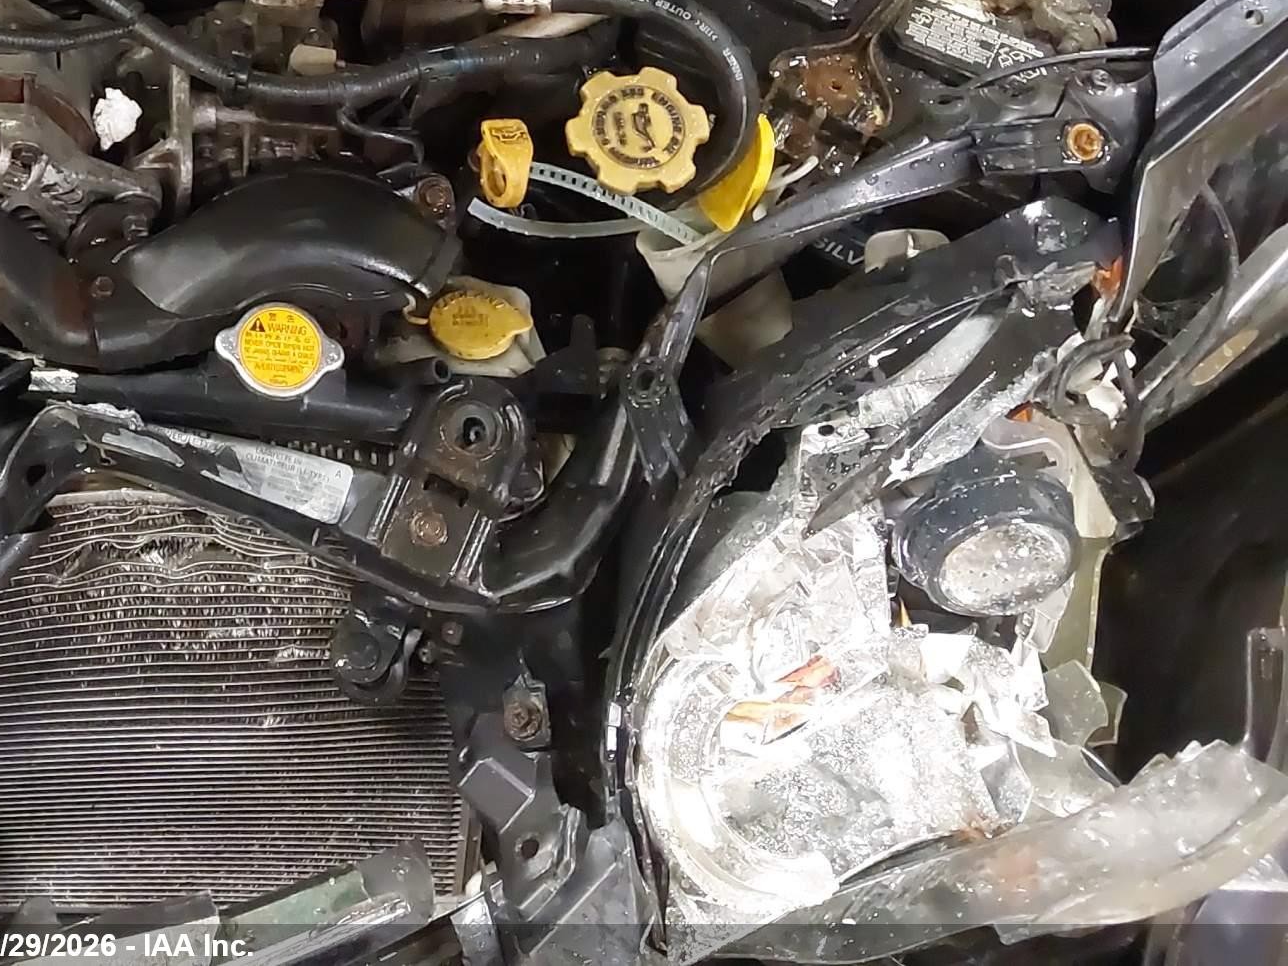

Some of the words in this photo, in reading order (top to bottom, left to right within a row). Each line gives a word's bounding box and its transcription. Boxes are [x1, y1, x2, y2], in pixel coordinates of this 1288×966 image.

[655, 0, 692, 21] OUTER
[723, 47, 744, 81] INNER
[652, 92, 683, 133] ENGINE
[267, 323, 307, 336] WARNING
[265, 340, 281, 349] OPEN
